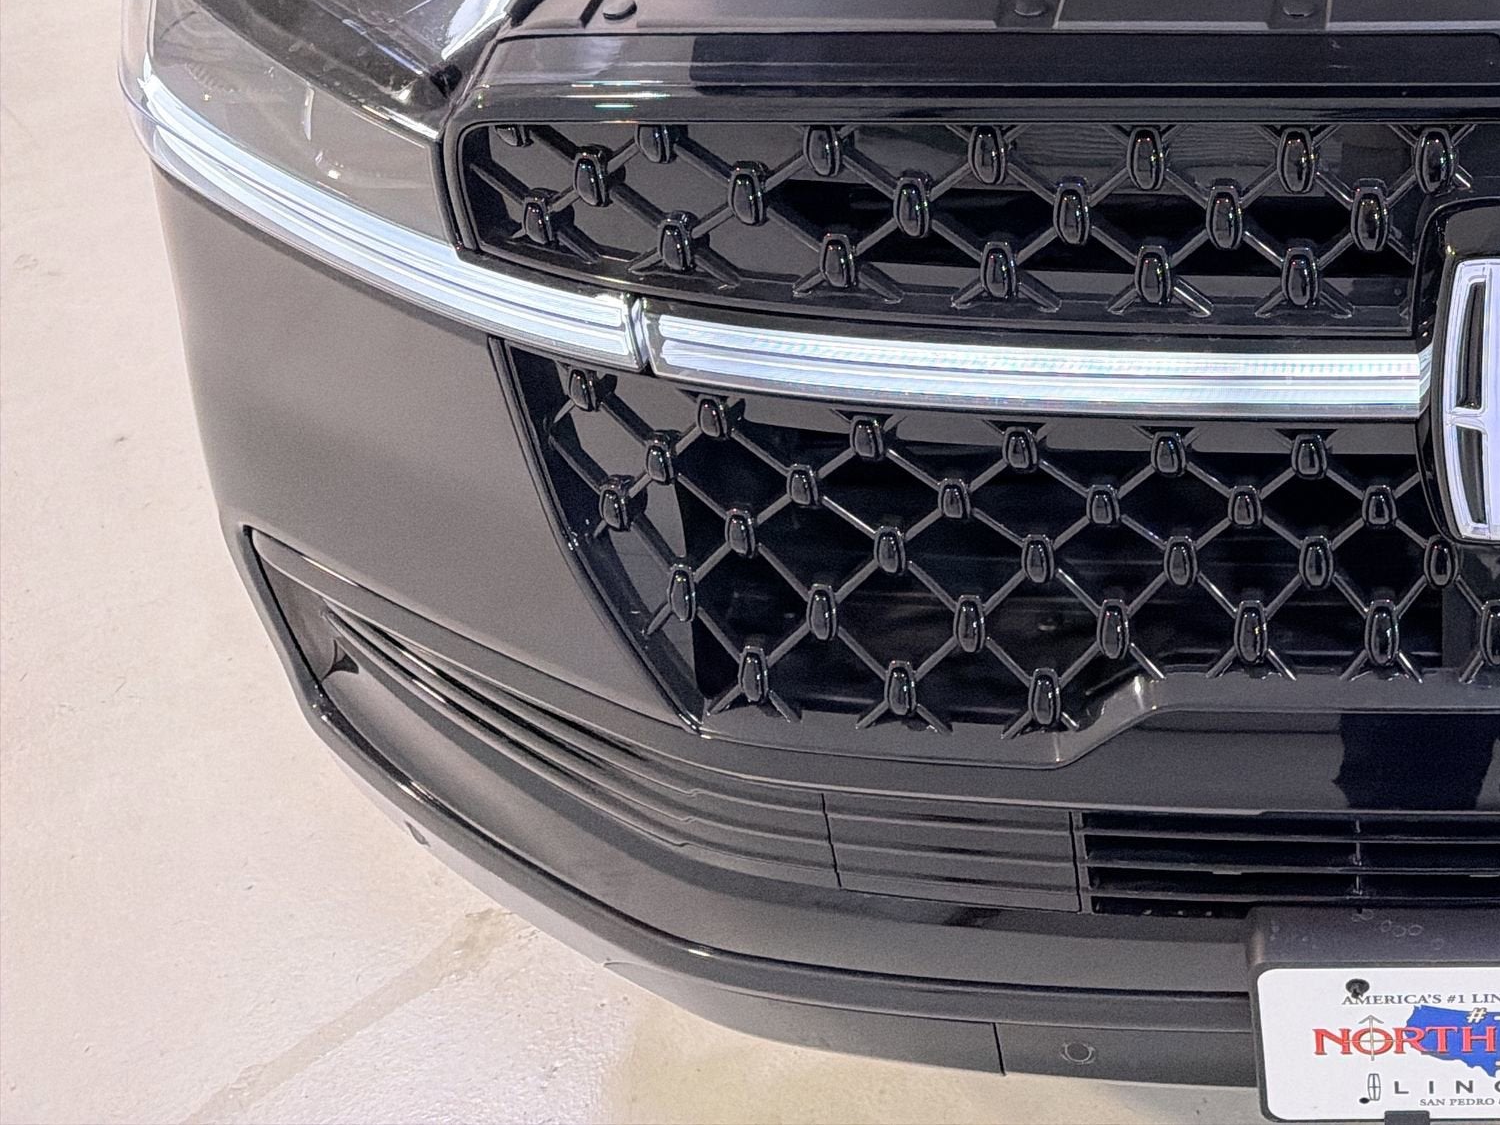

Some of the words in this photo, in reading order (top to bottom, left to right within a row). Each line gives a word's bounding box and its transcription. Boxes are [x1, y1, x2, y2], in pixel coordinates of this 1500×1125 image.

[1341, 994, 1442, 1006] AMERICA'S
[1446, 994, 1465, 1004] #1
[1312, 1025, 1498, 1056] NORTH
[1419, 1097, 1446, 1107] SAN
[1449, 1097, 1495, 1106] PEDRO
